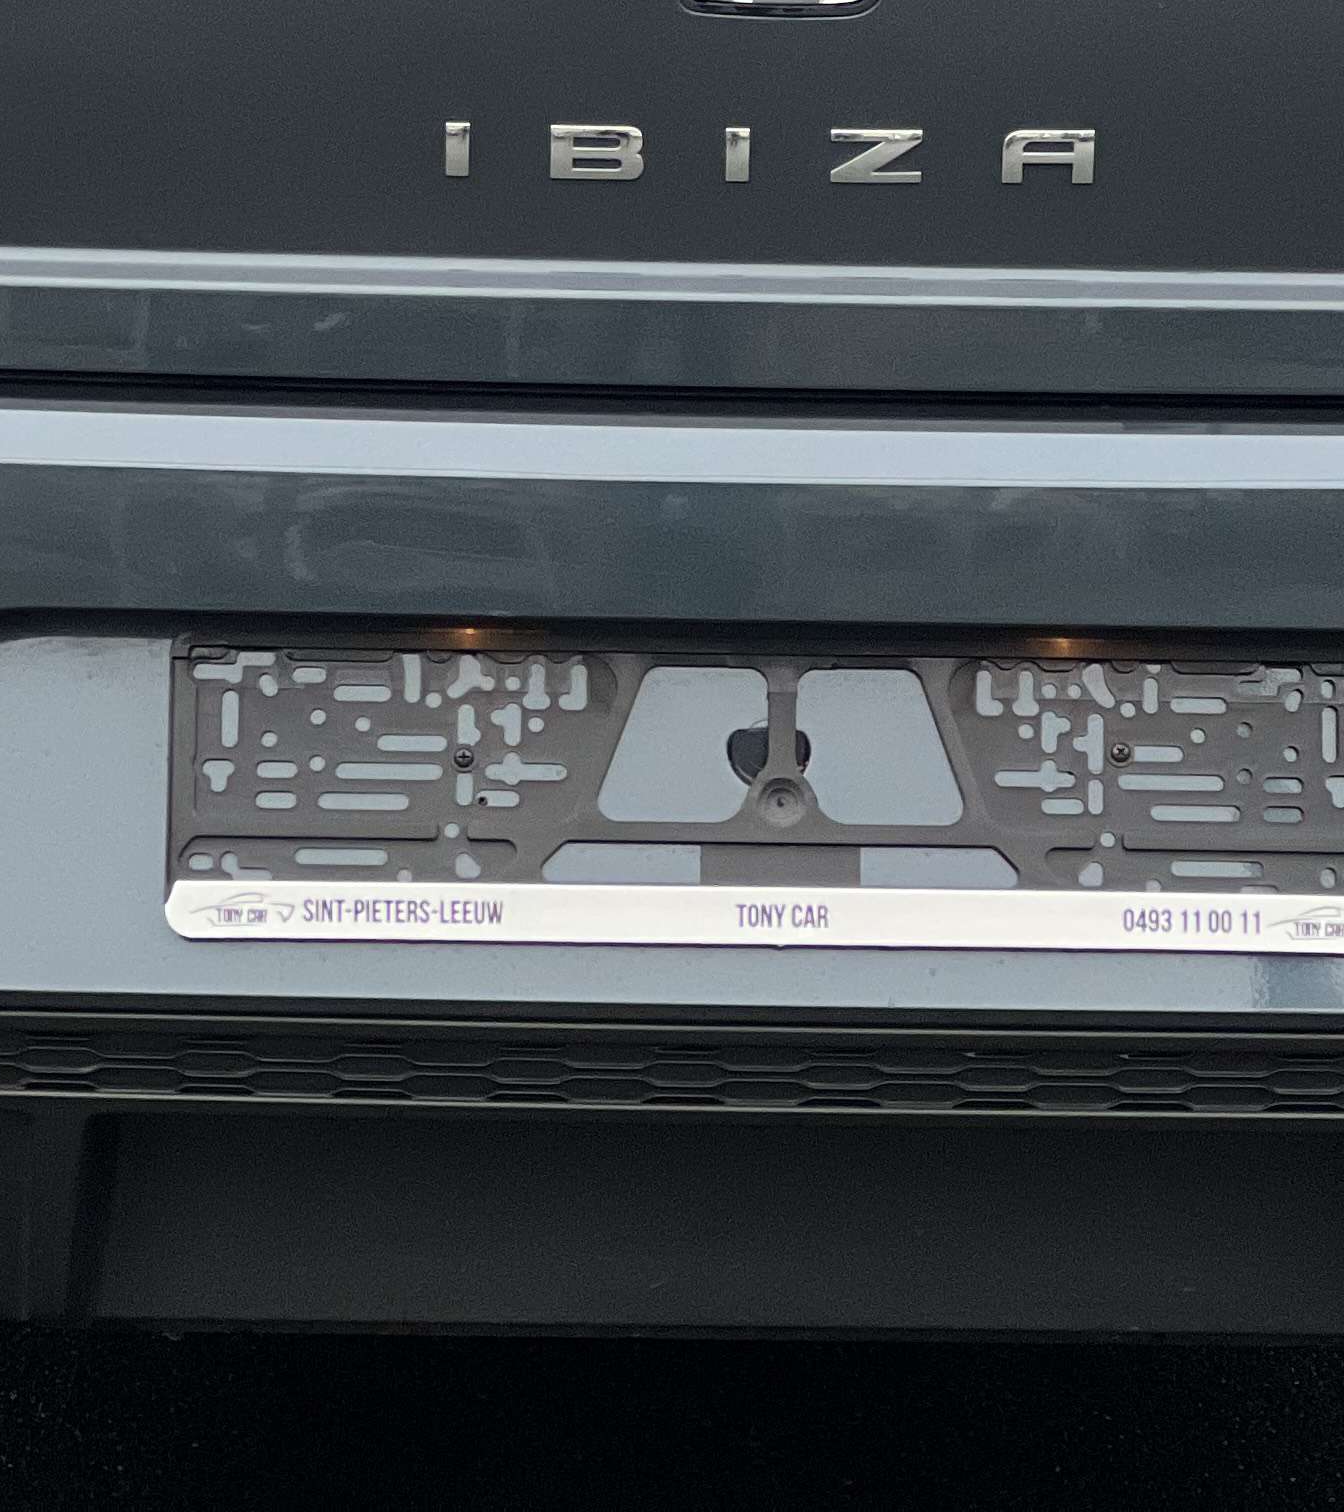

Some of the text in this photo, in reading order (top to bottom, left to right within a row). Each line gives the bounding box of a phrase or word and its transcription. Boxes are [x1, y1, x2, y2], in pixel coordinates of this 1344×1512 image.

[444, 121, 1096, 185] IBIZA
[302, 898, 504, 925] SINT-PIETERS-LEEUW
[735, 903, 829, 929] TONY CAR
[1122, 908, 1261, 934] 0493 11 00 11
